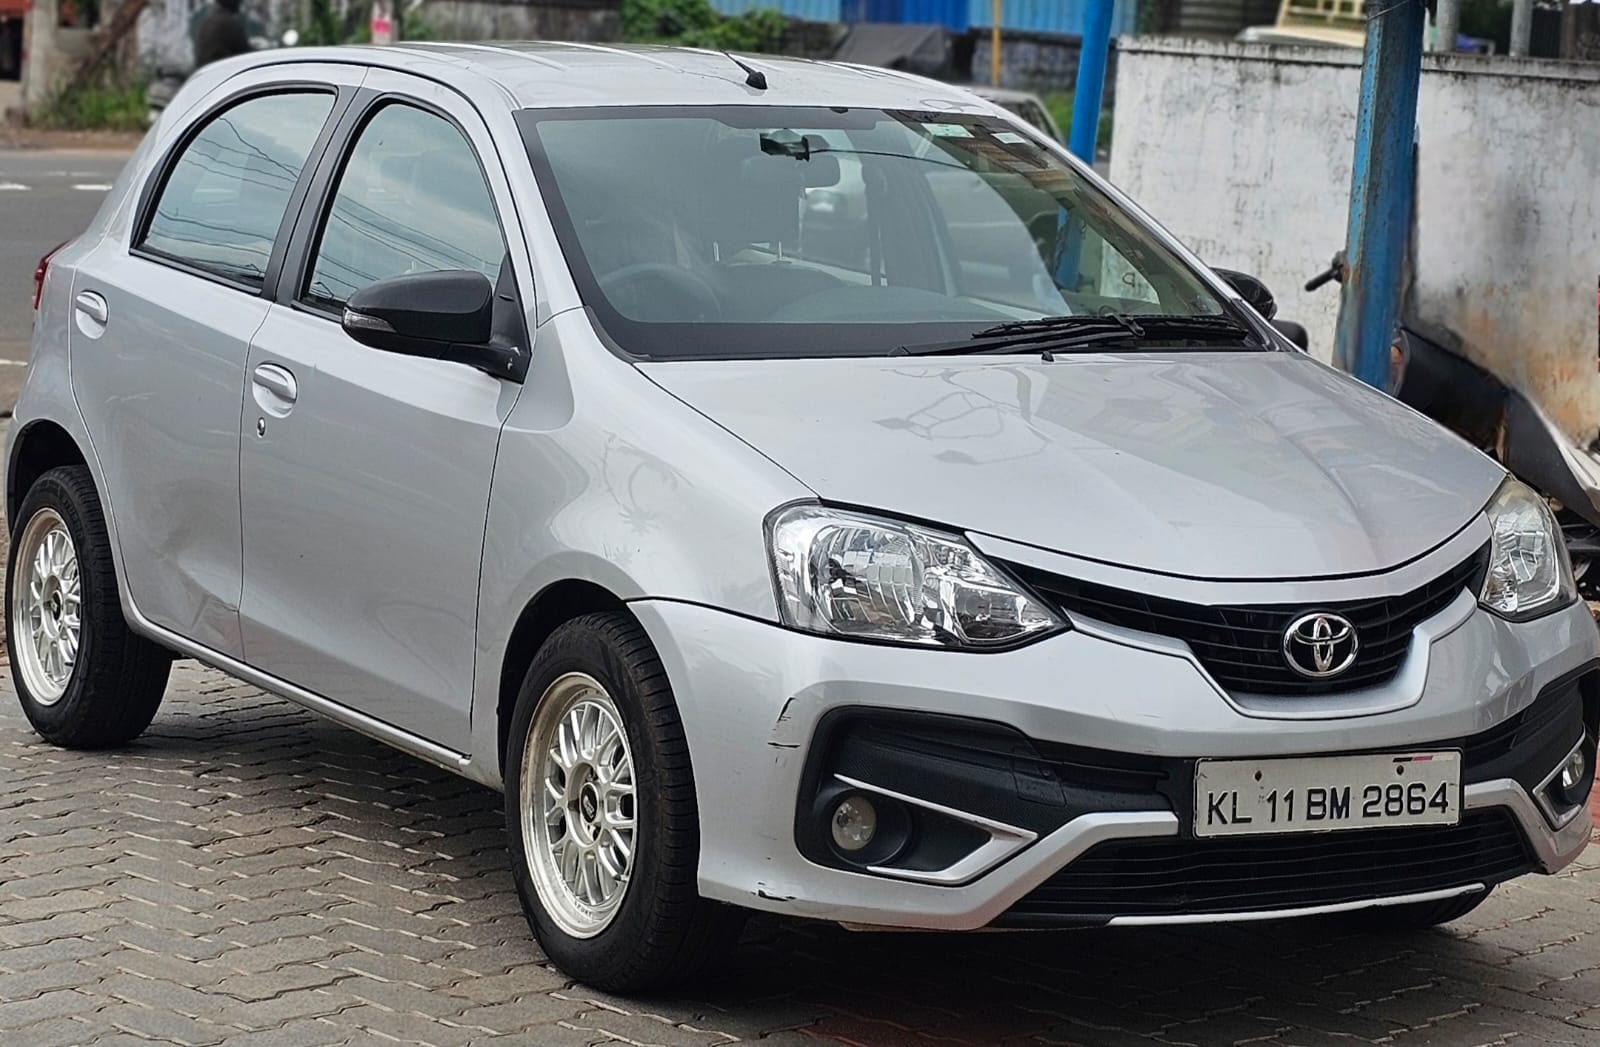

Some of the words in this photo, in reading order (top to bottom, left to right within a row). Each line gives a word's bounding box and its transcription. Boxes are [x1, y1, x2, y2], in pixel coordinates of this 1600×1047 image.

[1207, 791, 1252, 825] KL
[1266, 789, 1294, 822] 11
[1306, 786, 1350, 820] BM
[1362, 782, 1449, 817] 2864
